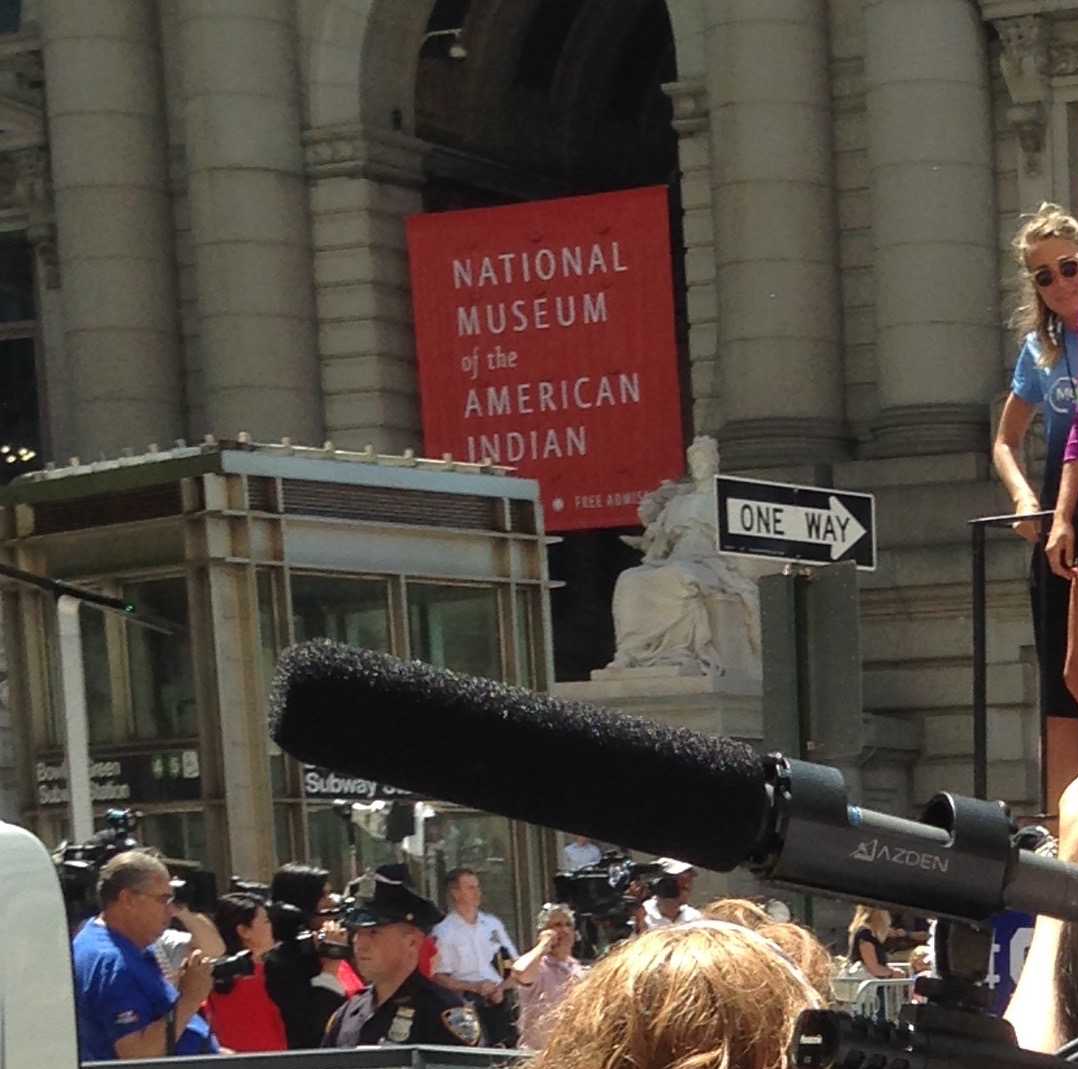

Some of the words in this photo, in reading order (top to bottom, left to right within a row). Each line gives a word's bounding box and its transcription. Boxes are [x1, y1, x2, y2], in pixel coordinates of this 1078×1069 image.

[453, 241, 628, 289] NATIONAL
[457, 292, 608, 337] MUSEUM
[461, 347, 480, 380] of
[487, 345, 518, 370] the
[465, 372, 641, 418] AMERICAN
[467, 426, 587, 463] INDIAN
[575, 494, 602, 509] FREE
[606, 490, 651, 507] ADMIS
[741, 504, 785, 535] ONE
[805, 512, 850, 543] WAY
[305, 772, 378, 798] Subway
[876, 844, 949, 873] AZDEN
